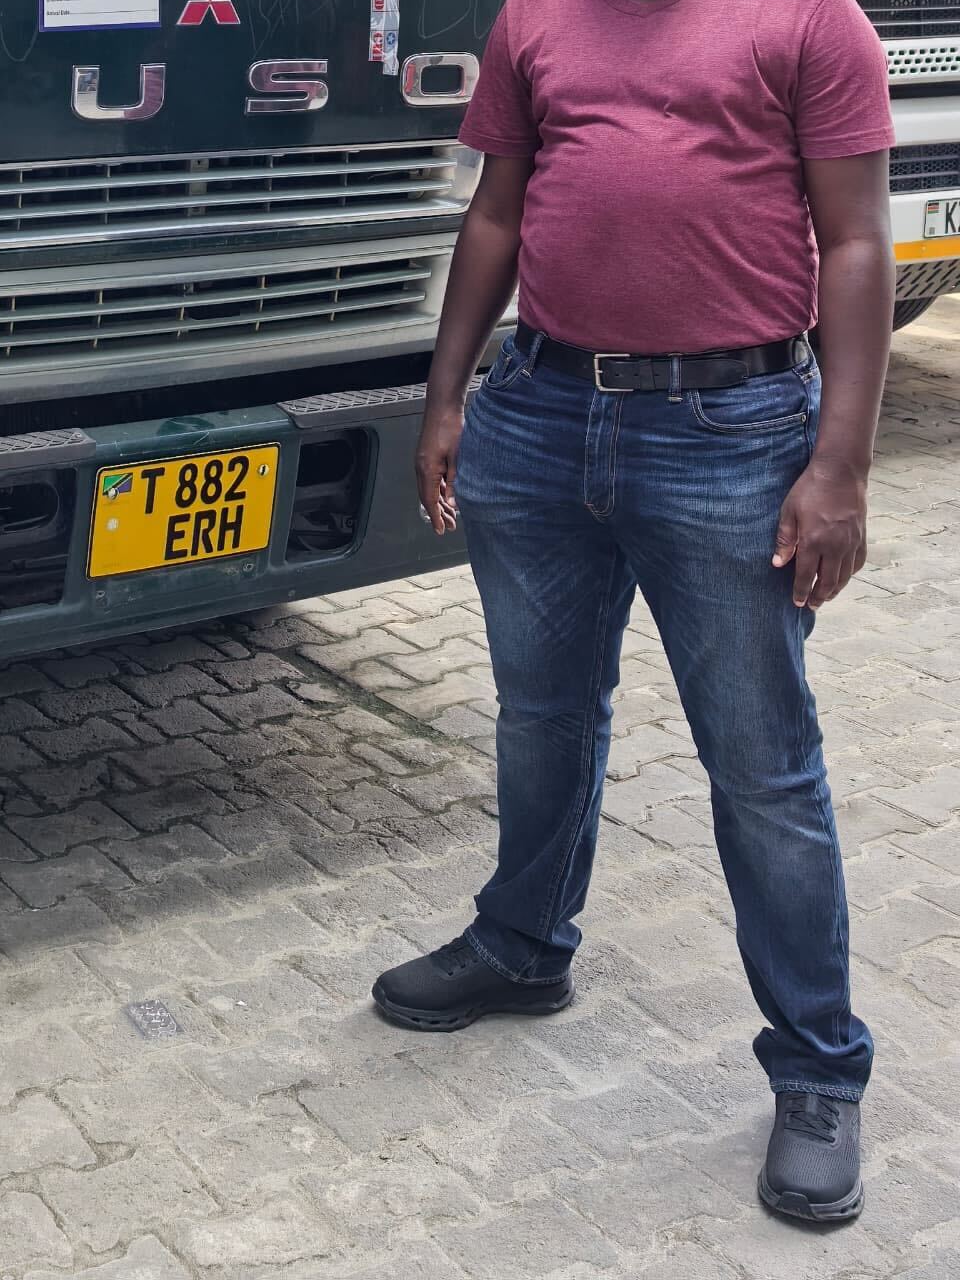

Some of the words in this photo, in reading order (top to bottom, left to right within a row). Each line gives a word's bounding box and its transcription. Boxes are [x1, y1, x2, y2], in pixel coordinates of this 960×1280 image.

[141, 467, 165, 514] T
[175, 455, 250, 508] 882
[164, 504, 244, 561] ERH
